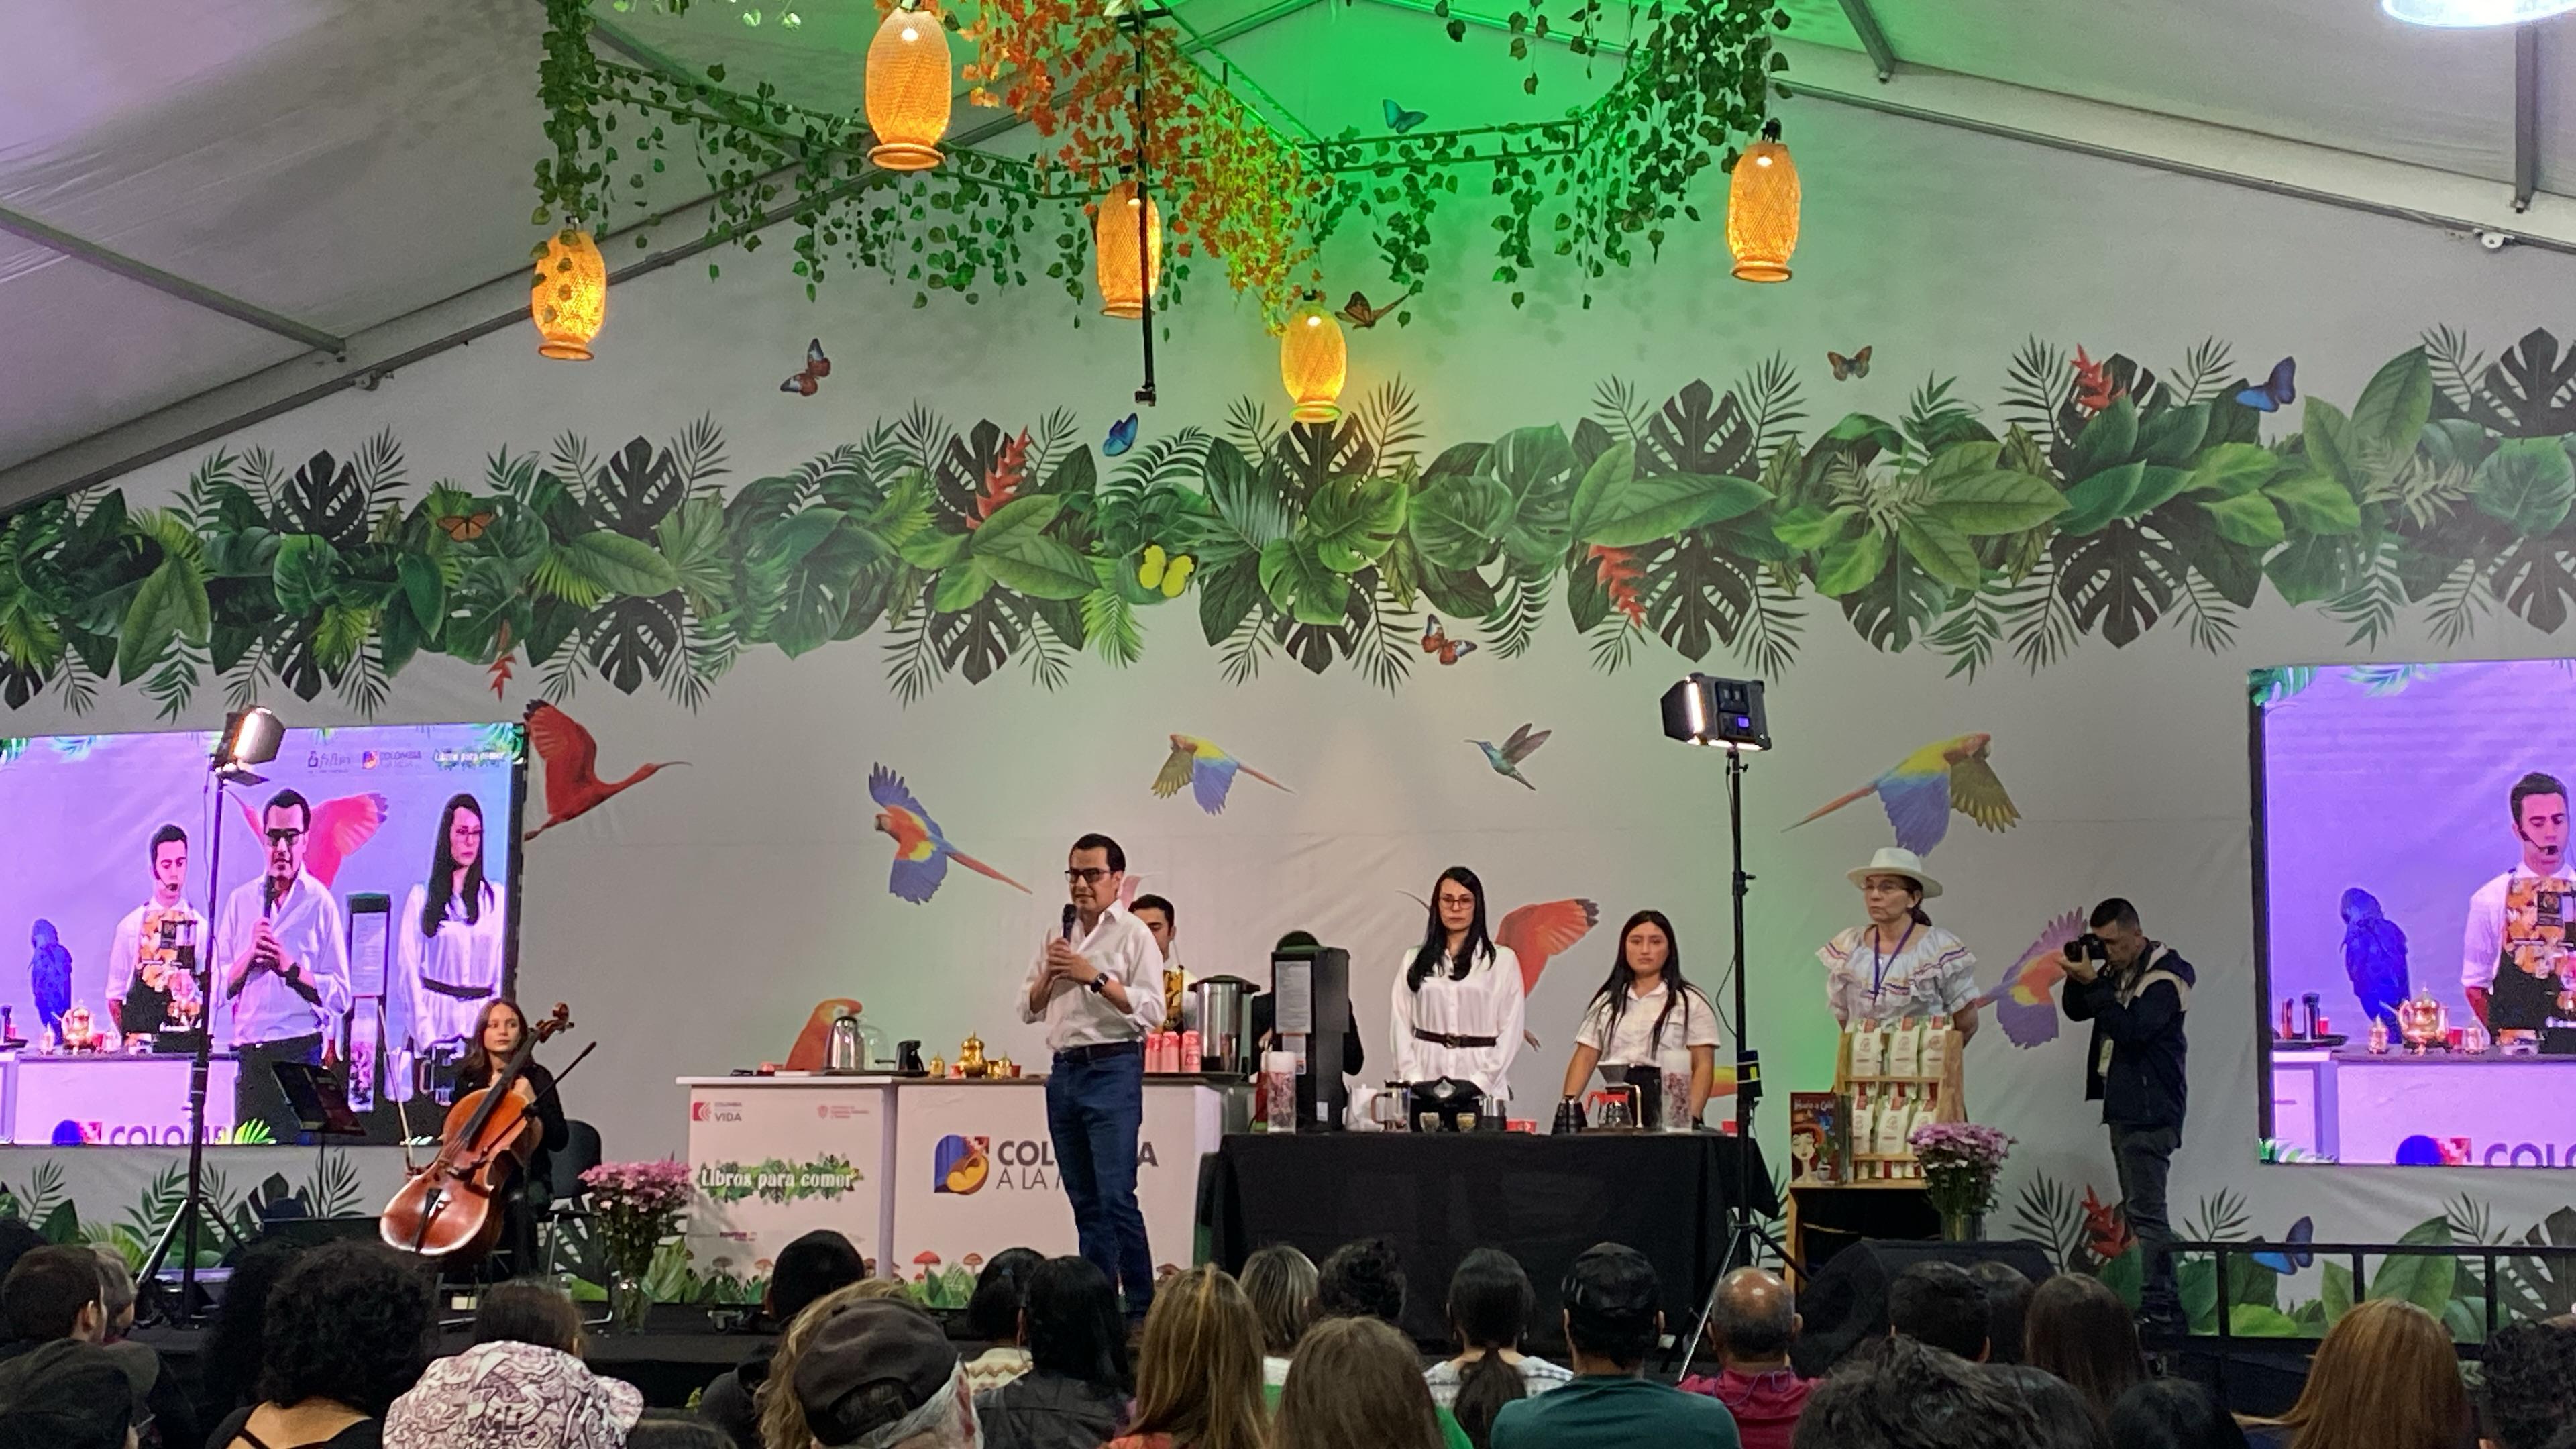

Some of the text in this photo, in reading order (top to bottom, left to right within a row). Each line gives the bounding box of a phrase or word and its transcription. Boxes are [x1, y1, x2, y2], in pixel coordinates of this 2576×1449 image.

[714, 1112, 742, 1122] VIDA
[701, 1169, 852, 1189] Libros para comer
[996, 1169, 1014, 1190] A
[1022, 1168, 1047, 1191] LA
